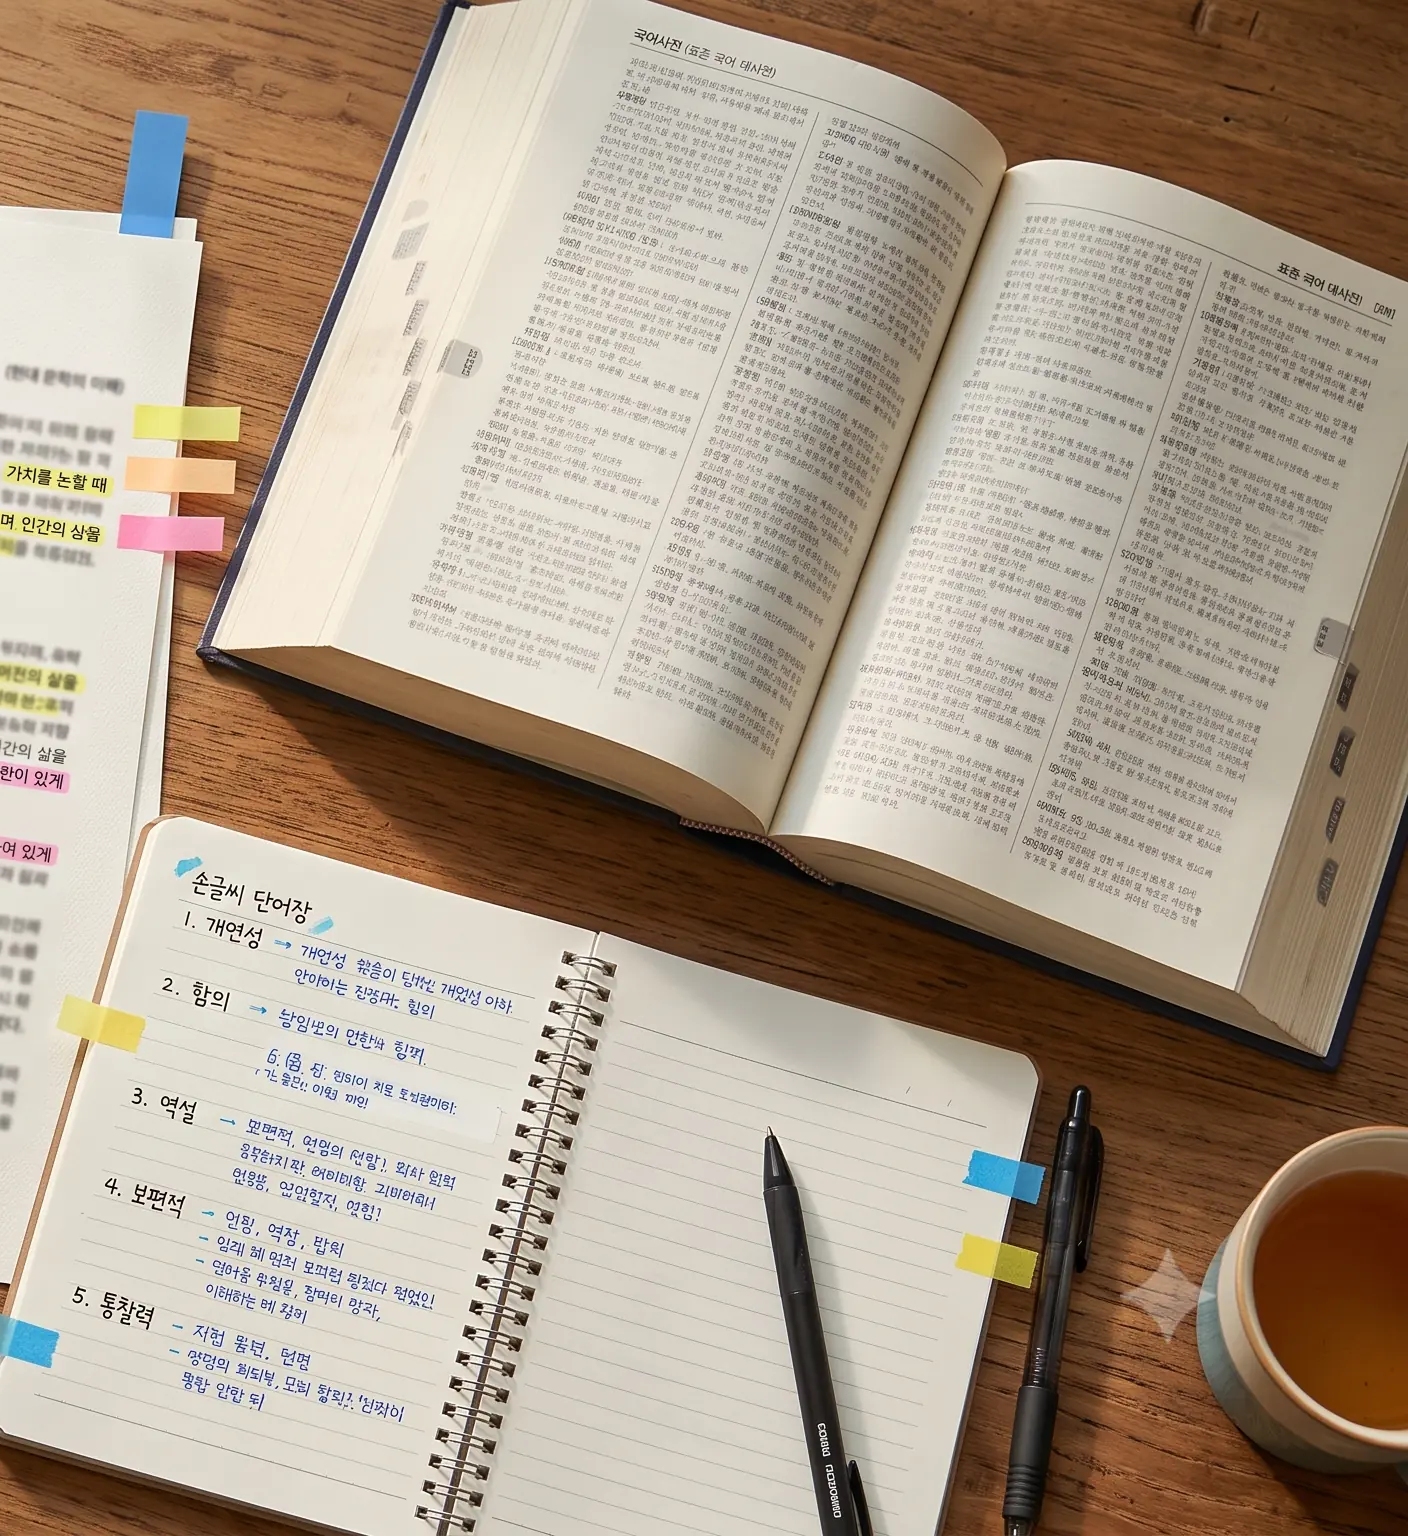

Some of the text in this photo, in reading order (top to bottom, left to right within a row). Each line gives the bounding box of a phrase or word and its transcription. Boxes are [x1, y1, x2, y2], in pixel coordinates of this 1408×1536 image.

[634, 28, 683, 53] 국어사전
[7, 465, 107, 494] 가치를 논할 때
[23, 516, 66, 538] 인간의
[37, 746, 67, 765] 삶을
[34, 770, 64, 790] 있게
[22, 844, 52, 863] 있게
[192, 872, 312, 924] 손글씨 단어장
[184, 911, 195, 928] 1.
[207, 917, 263, 949] 개연성
[162, 977, 180, 996] 2.
[193, 981, 230, 1012] 함의
[132, 1087, 148, 1106] 3.
[160, 1095, 197, 1125] 역설
[104, 1178, 122, 1197] 4.
[131, 1183, 186, 1219] 보편적
[72, 1286, 89, 1307] 5.
[100, 1291, 155, 1330] 통찰력
